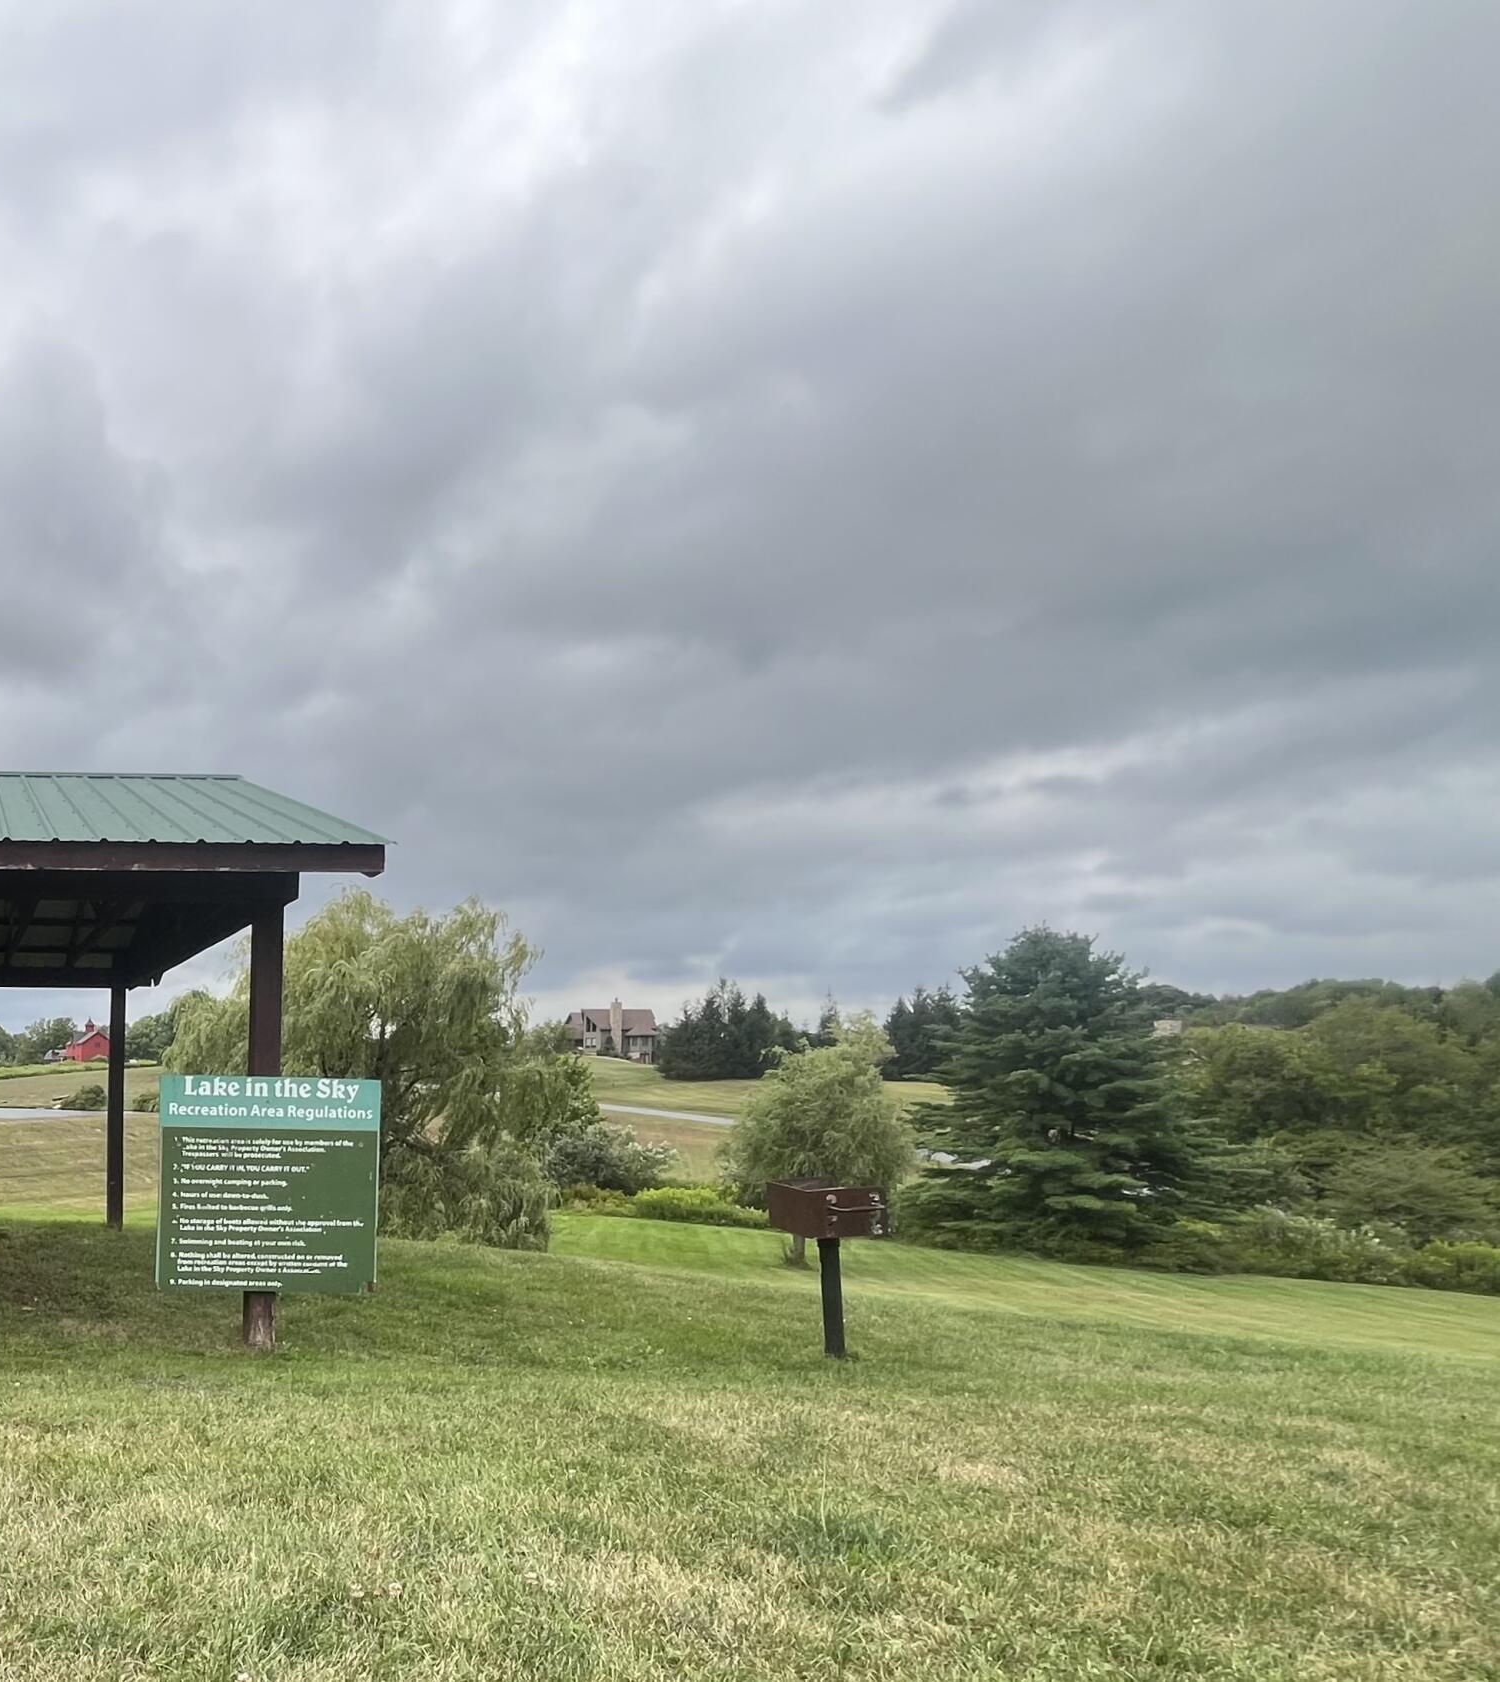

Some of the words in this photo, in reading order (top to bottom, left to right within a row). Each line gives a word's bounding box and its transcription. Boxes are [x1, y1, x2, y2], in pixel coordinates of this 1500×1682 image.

[184, 1075, 240, 1097] Lake
[245, 1077, 269, 1097] in
[275, 1079, 312, 1099] the
[316, 1079, 360, 1103] Sky
[169, 1102, 247, 1117] Recreation
[250, 1105, 284, 1118] Area
[287, 1106, 373, 1121] Regulations
[295, 1139, 303, 1147] by
[191, 1178, 223, 1186] overnight
[224, 1179, 252, 1187] camping
[216, 1225, 227, 1233] Sky
[228, 1225, 257, 1233] Property
[179, 1252, 205, 1260] Nothing
[178, 1279, 203, 1287] Parking
